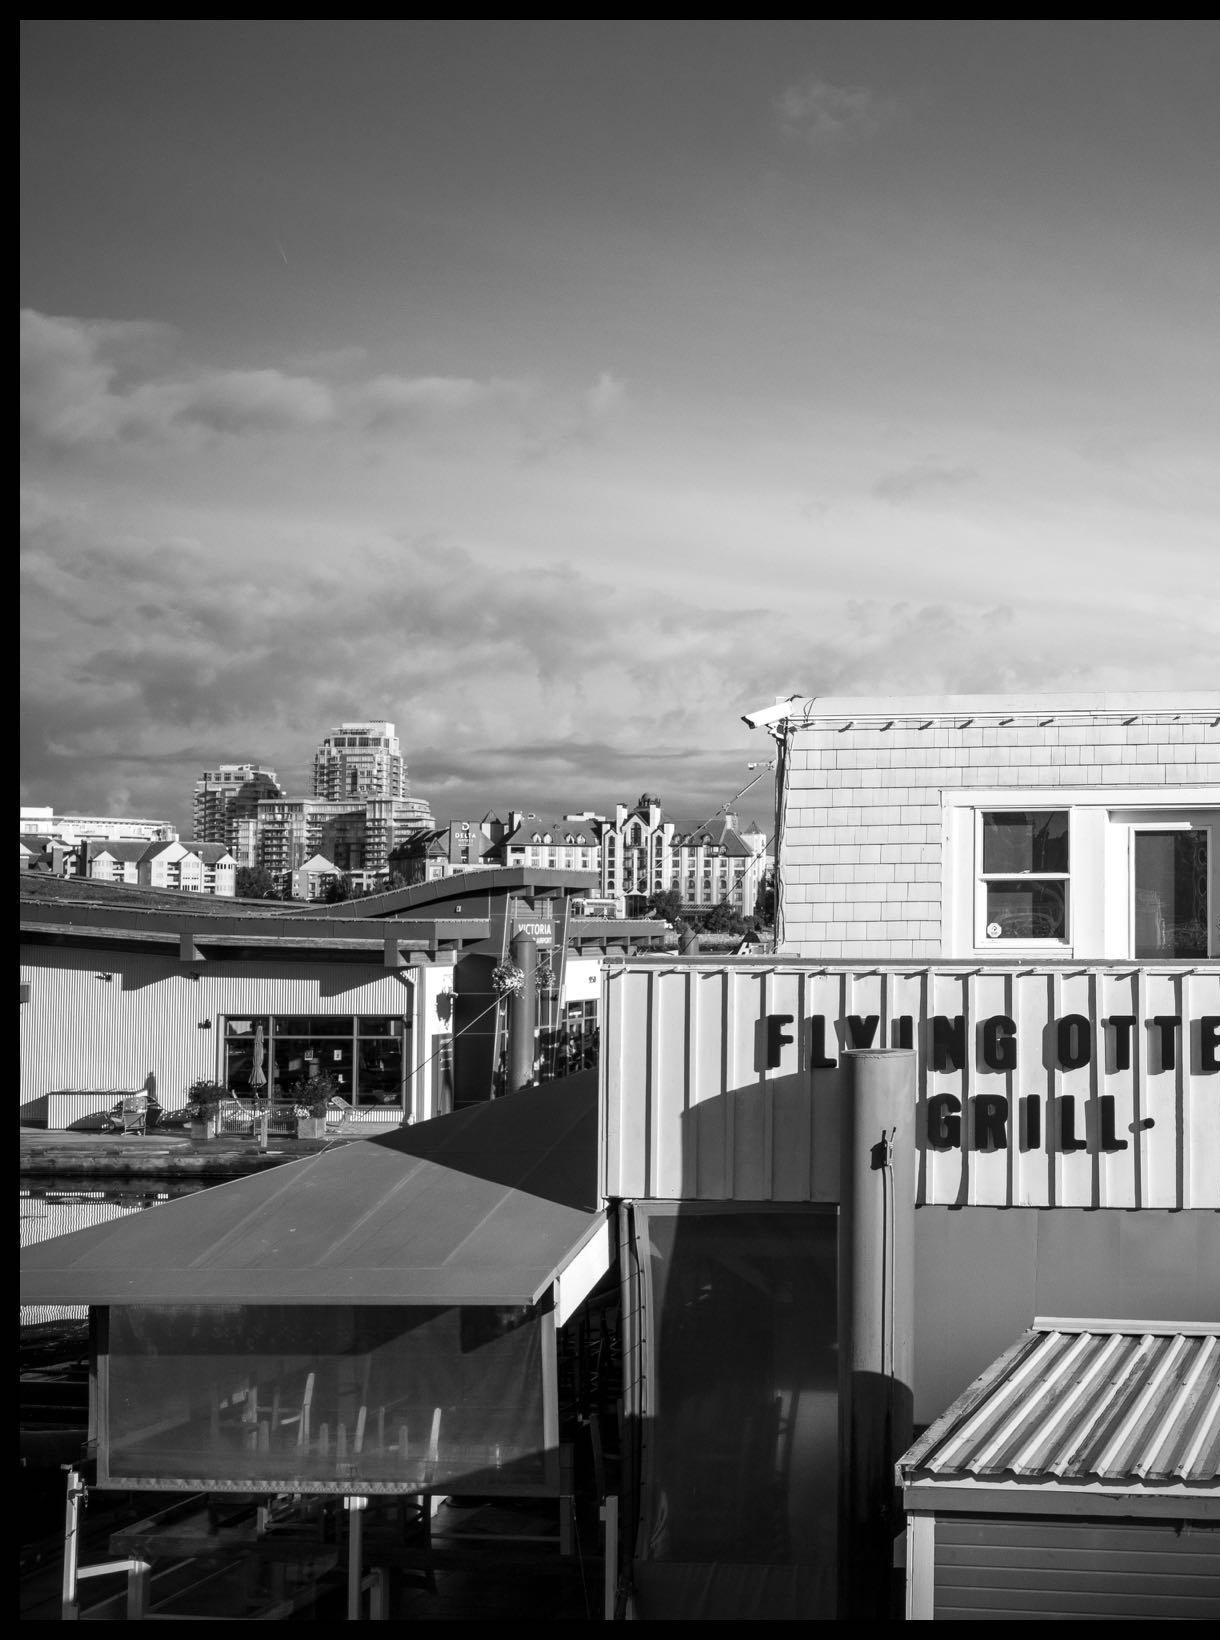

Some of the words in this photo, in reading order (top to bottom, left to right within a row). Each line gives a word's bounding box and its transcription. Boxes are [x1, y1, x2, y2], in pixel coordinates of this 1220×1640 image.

[518, 923, 552, 935] VICTORIA
[768, 1015, 1016, 1070] FLYING
[927, 1093, 1128, 1150] GRILL
